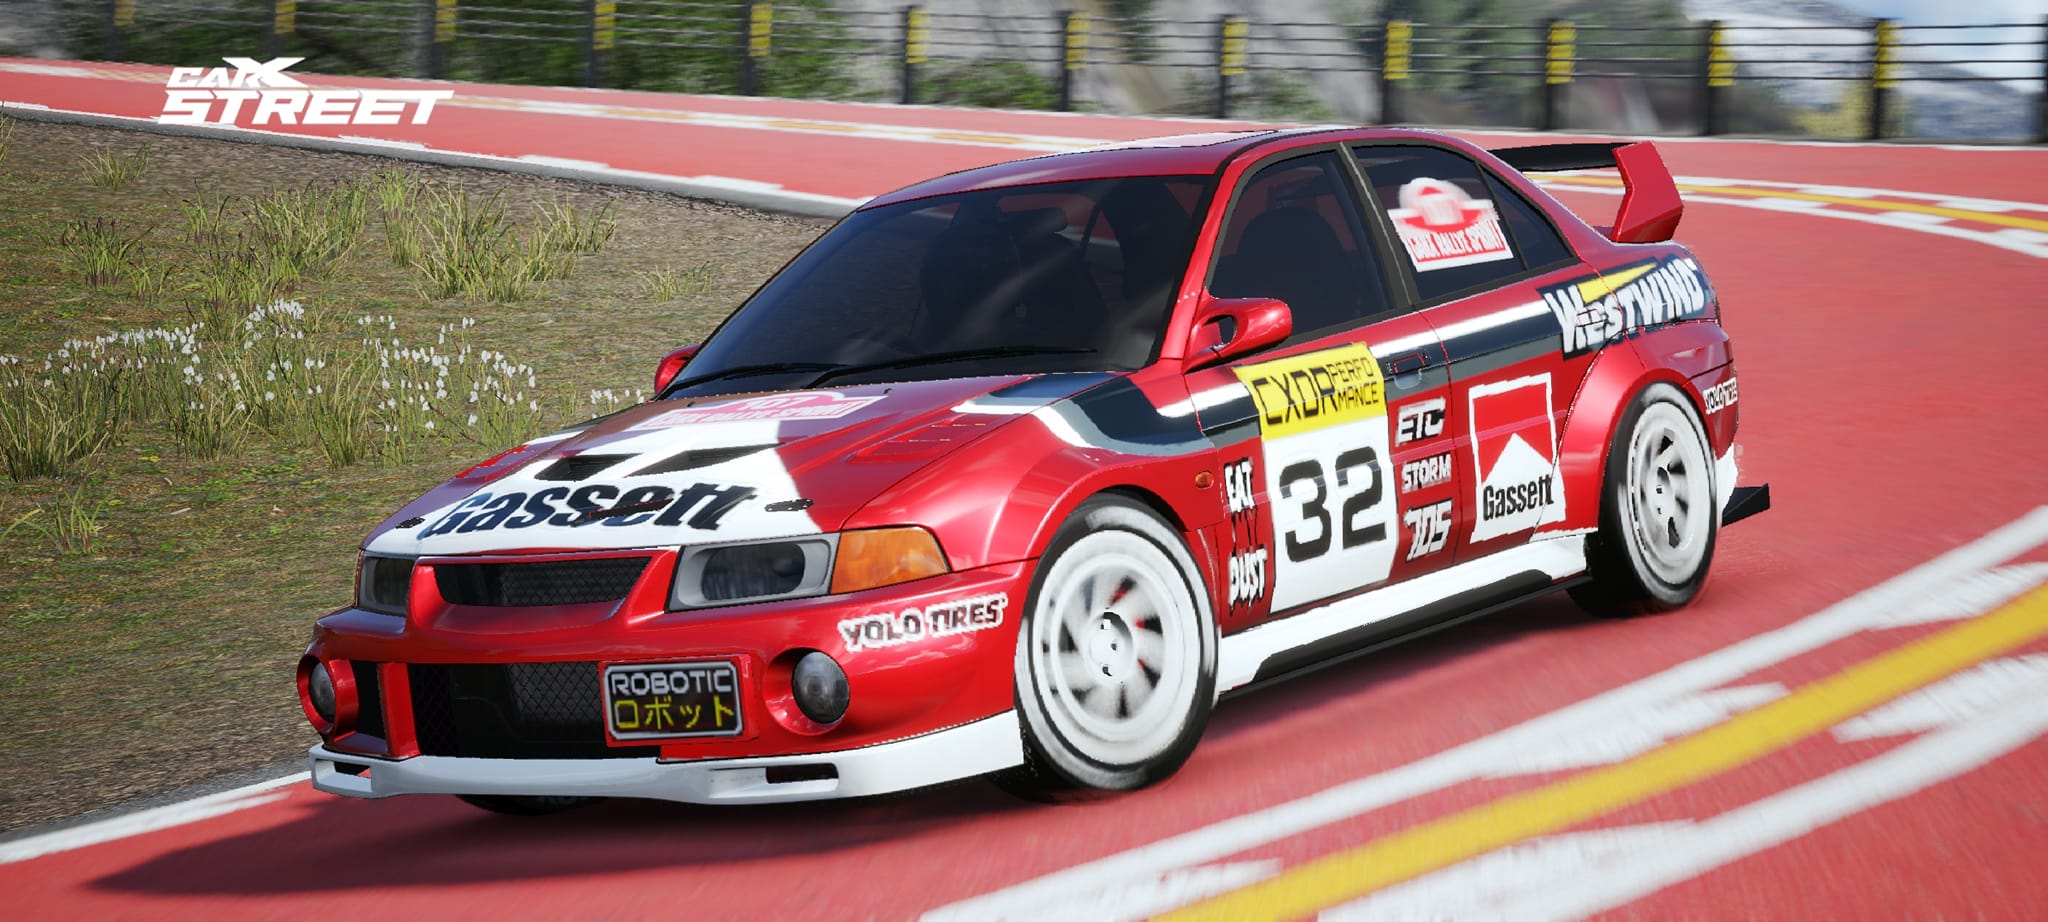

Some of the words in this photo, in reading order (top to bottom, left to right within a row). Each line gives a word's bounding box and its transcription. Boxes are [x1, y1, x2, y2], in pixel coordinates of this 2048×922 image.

[1326, 357, 1374, 383] PERFO
[1338, 381, 1379, 410] MANCE
[1395, 397, 1446, 446] ETC
[1225, 459, 1255, 513] EAT
[1402, 454, 1452, 492] STORM
[416, 483, 757, 540] Gassett
[1279, 446, 1387, 562] 32
[1483, 474, 1554, 521] Gassett
[1229, 548, 1267, 609] DUST
[842, 612, 923, 648] YOLO
[929, 599, 1002, 633] TIRES
[611, 669, 732, 695] ROBOTIC
[614, 695, 735, 730] ロボット
